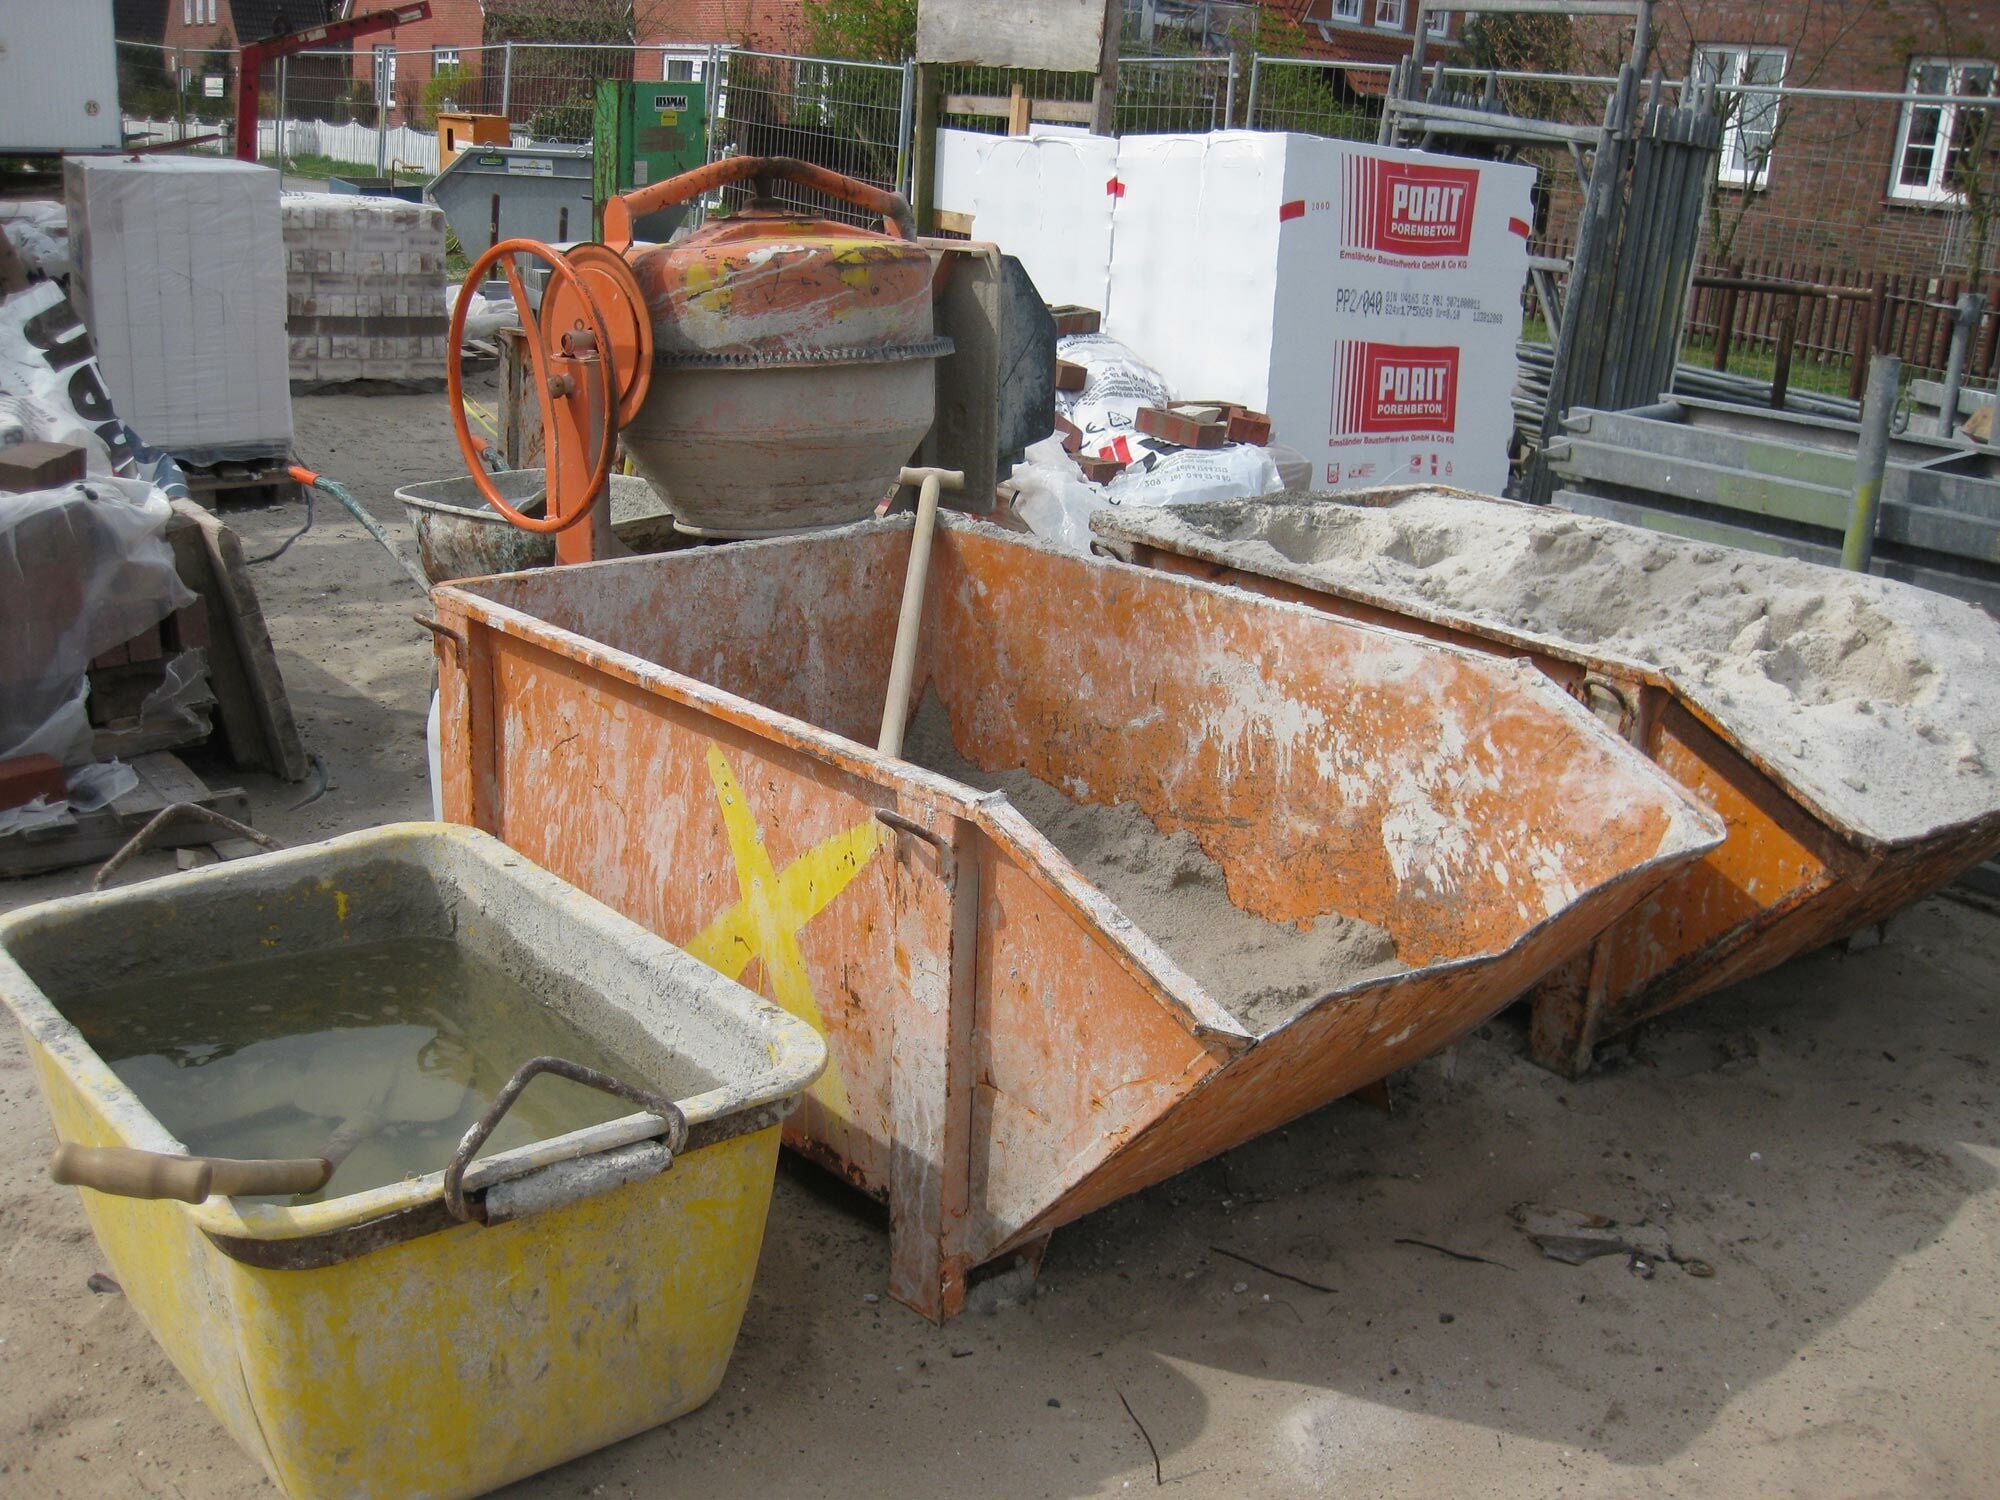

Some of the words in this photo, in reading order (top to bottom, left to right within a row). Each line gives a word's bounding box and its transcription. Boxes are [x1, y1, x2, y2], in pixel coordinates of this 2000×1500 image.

[1311, 201, 1330, 211] 2000
[1392, 183, 1464, 222] PORIT
[1391, 222, 1456, 237] PORENBETON
[1339, 250, 1377, 263] Emsländer
[1378, 255, 1421, 269] Baustoffwerke
[1422, 260, 1440, 270] GmbH
[1441, 260, 1446, 269] &
[1448, 260, 1457, 269] Co
[1457, 260, 1468, 269] KG
[1335, 288, 1383, 317] PP2/040
[1378, 366, 1447, 402] PORIT
[1377, 403, 1442, 415] PORENBETON
[1328, 438, 1362, 447] Emsländer
[1363, 436, 1409, 445] Baustoffwerke
[1410, 433, 1430, 442] GmbH
[1431, 434, 1435, 442] &
[1445, 436, 1455, 444] KG
